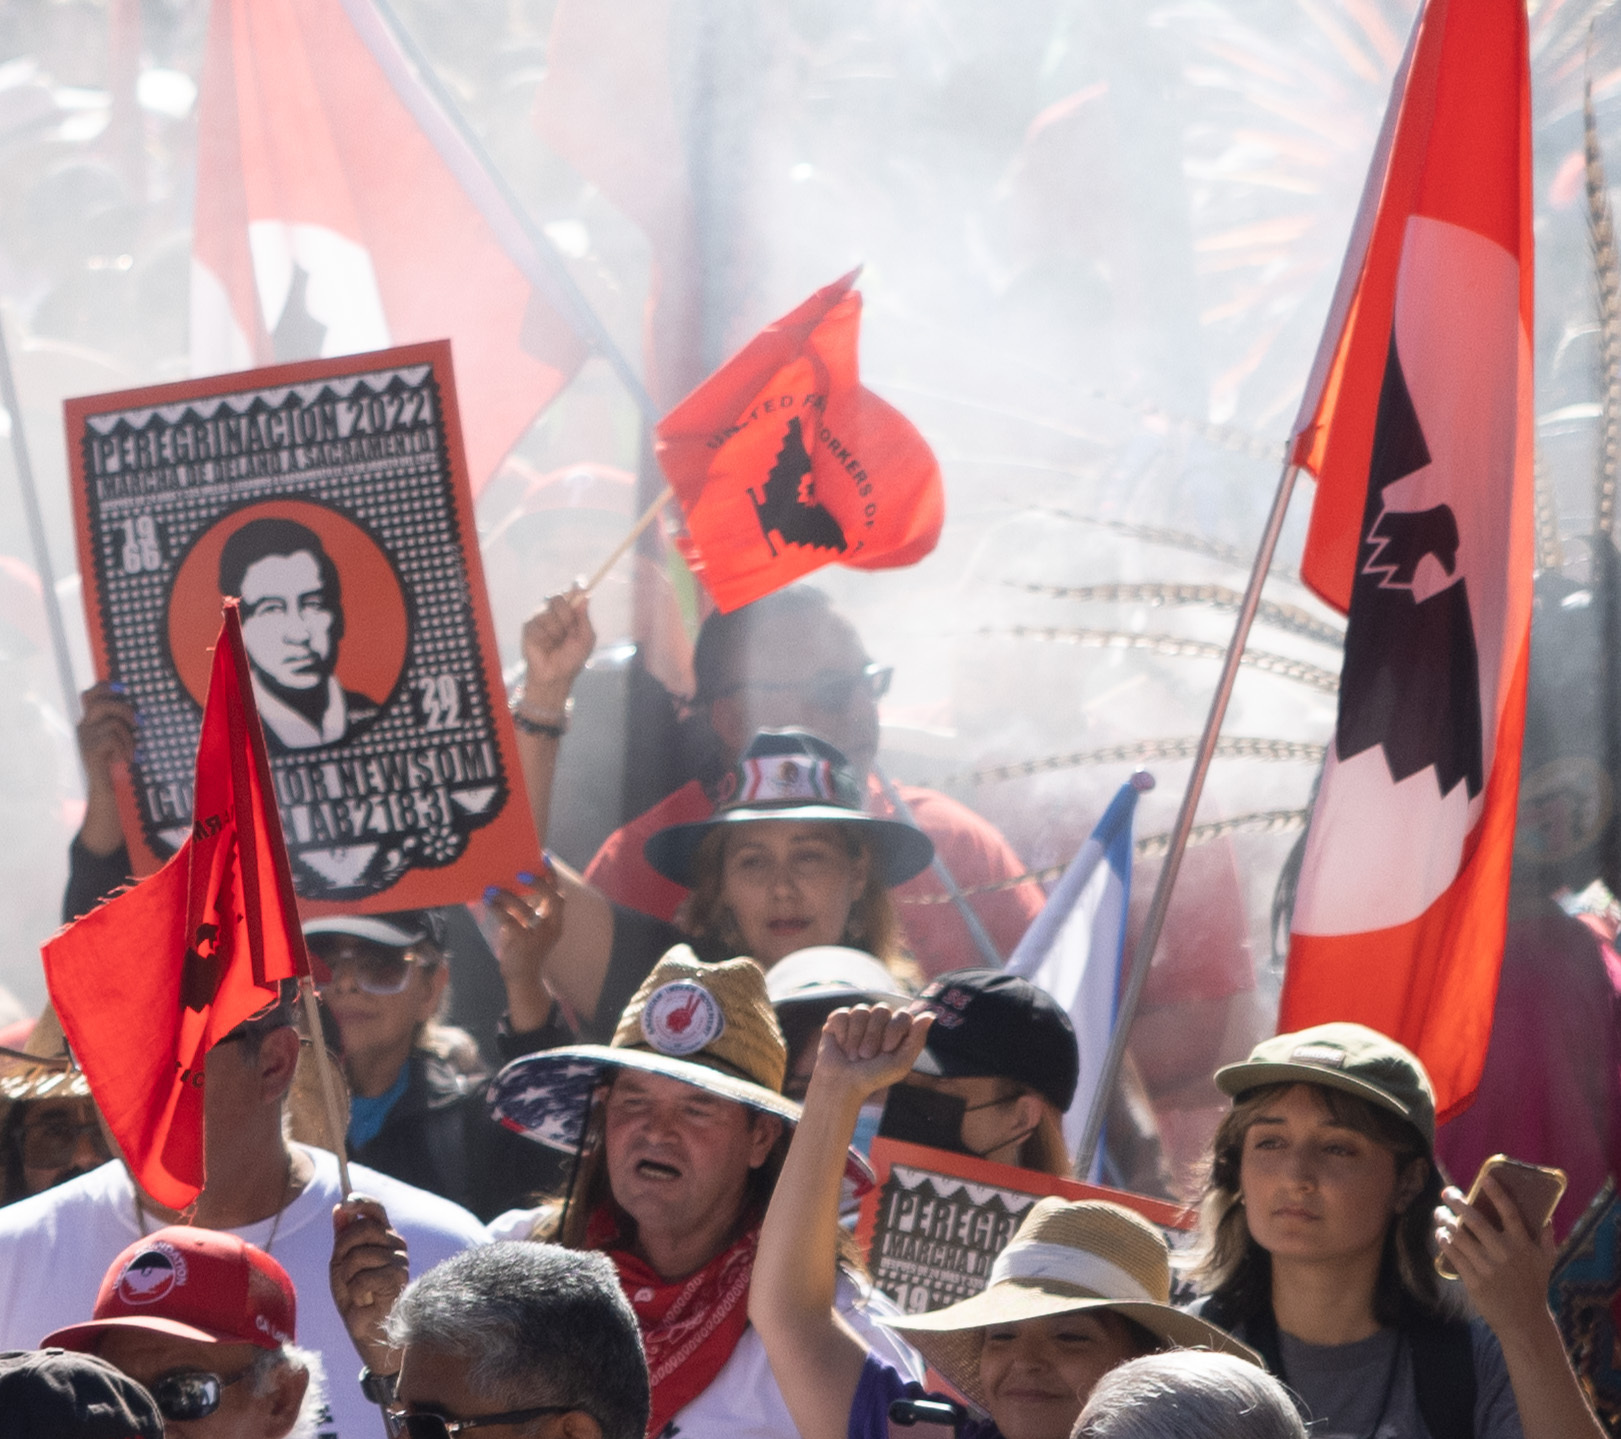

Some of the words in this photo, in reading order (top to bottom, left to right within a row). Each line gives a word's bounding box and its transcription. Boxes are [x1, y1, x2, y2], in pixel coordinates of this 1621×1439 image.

[343, 388, 433, 438] 2022
[817, 421, 873, 498] ORKERS
[121, 514, 156, 542] 19
[121, 540, 163, 574] 66
[418, 675, 459, 706] 20
[424, 701, 462, 732] 22
[334, 741, 495, 797] NEWSOM
[885, 1231, 966, 1274] MARCHA
